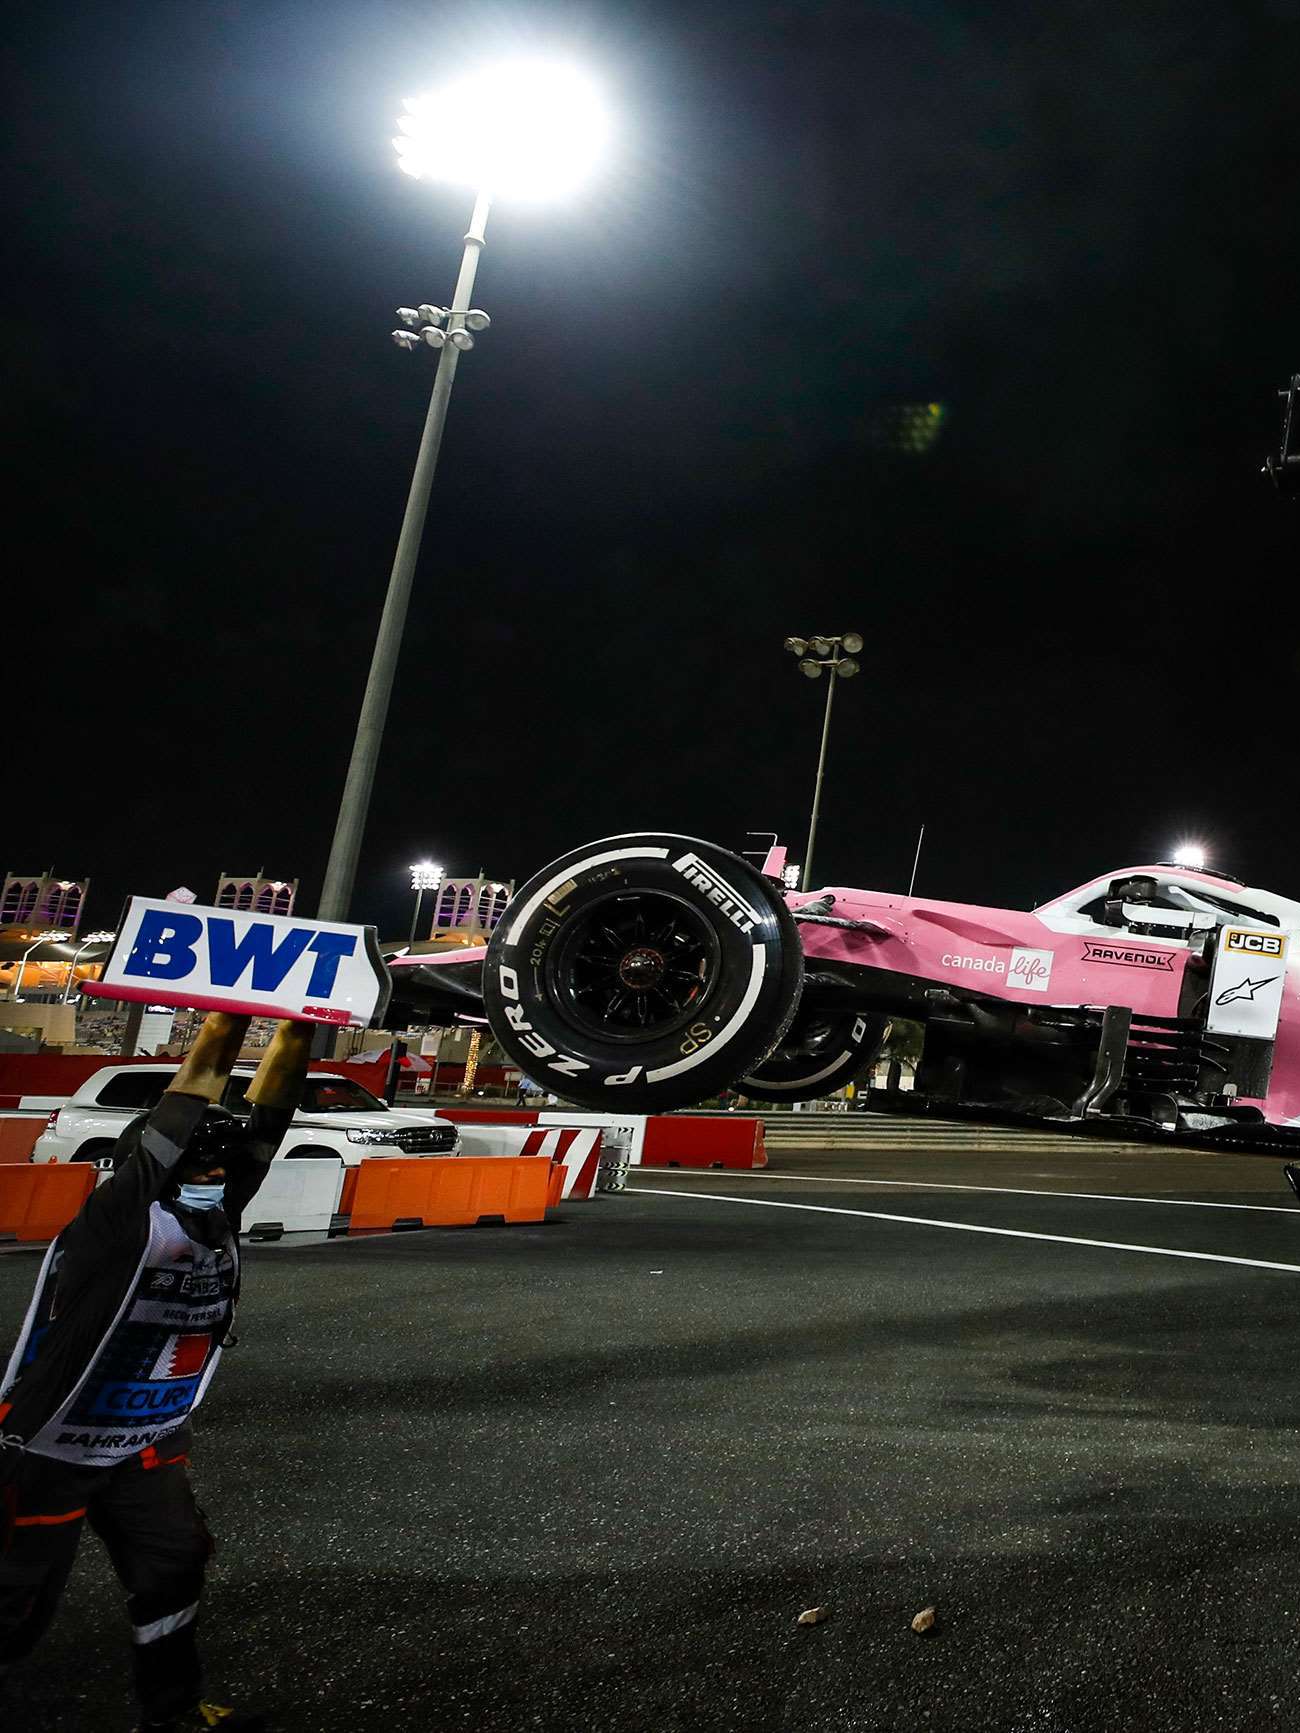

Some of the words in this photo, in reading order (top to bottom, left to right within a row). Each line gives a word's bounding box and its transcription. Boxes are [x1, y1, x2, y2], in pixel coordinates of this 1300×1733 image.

[672, 851, 764, 934] PIRELLI
[123, 909, 358, 999] BWT
[1092, 949, 1166, 966] RAVENOL
[1230, 933, 1283, 955] JCB
[941, 952, 1005, 974] canada
[1007, 956, 1051, 986] life
[499, 964, 590, 1078] ZERO
[604, 1065, 643, 1086] P
